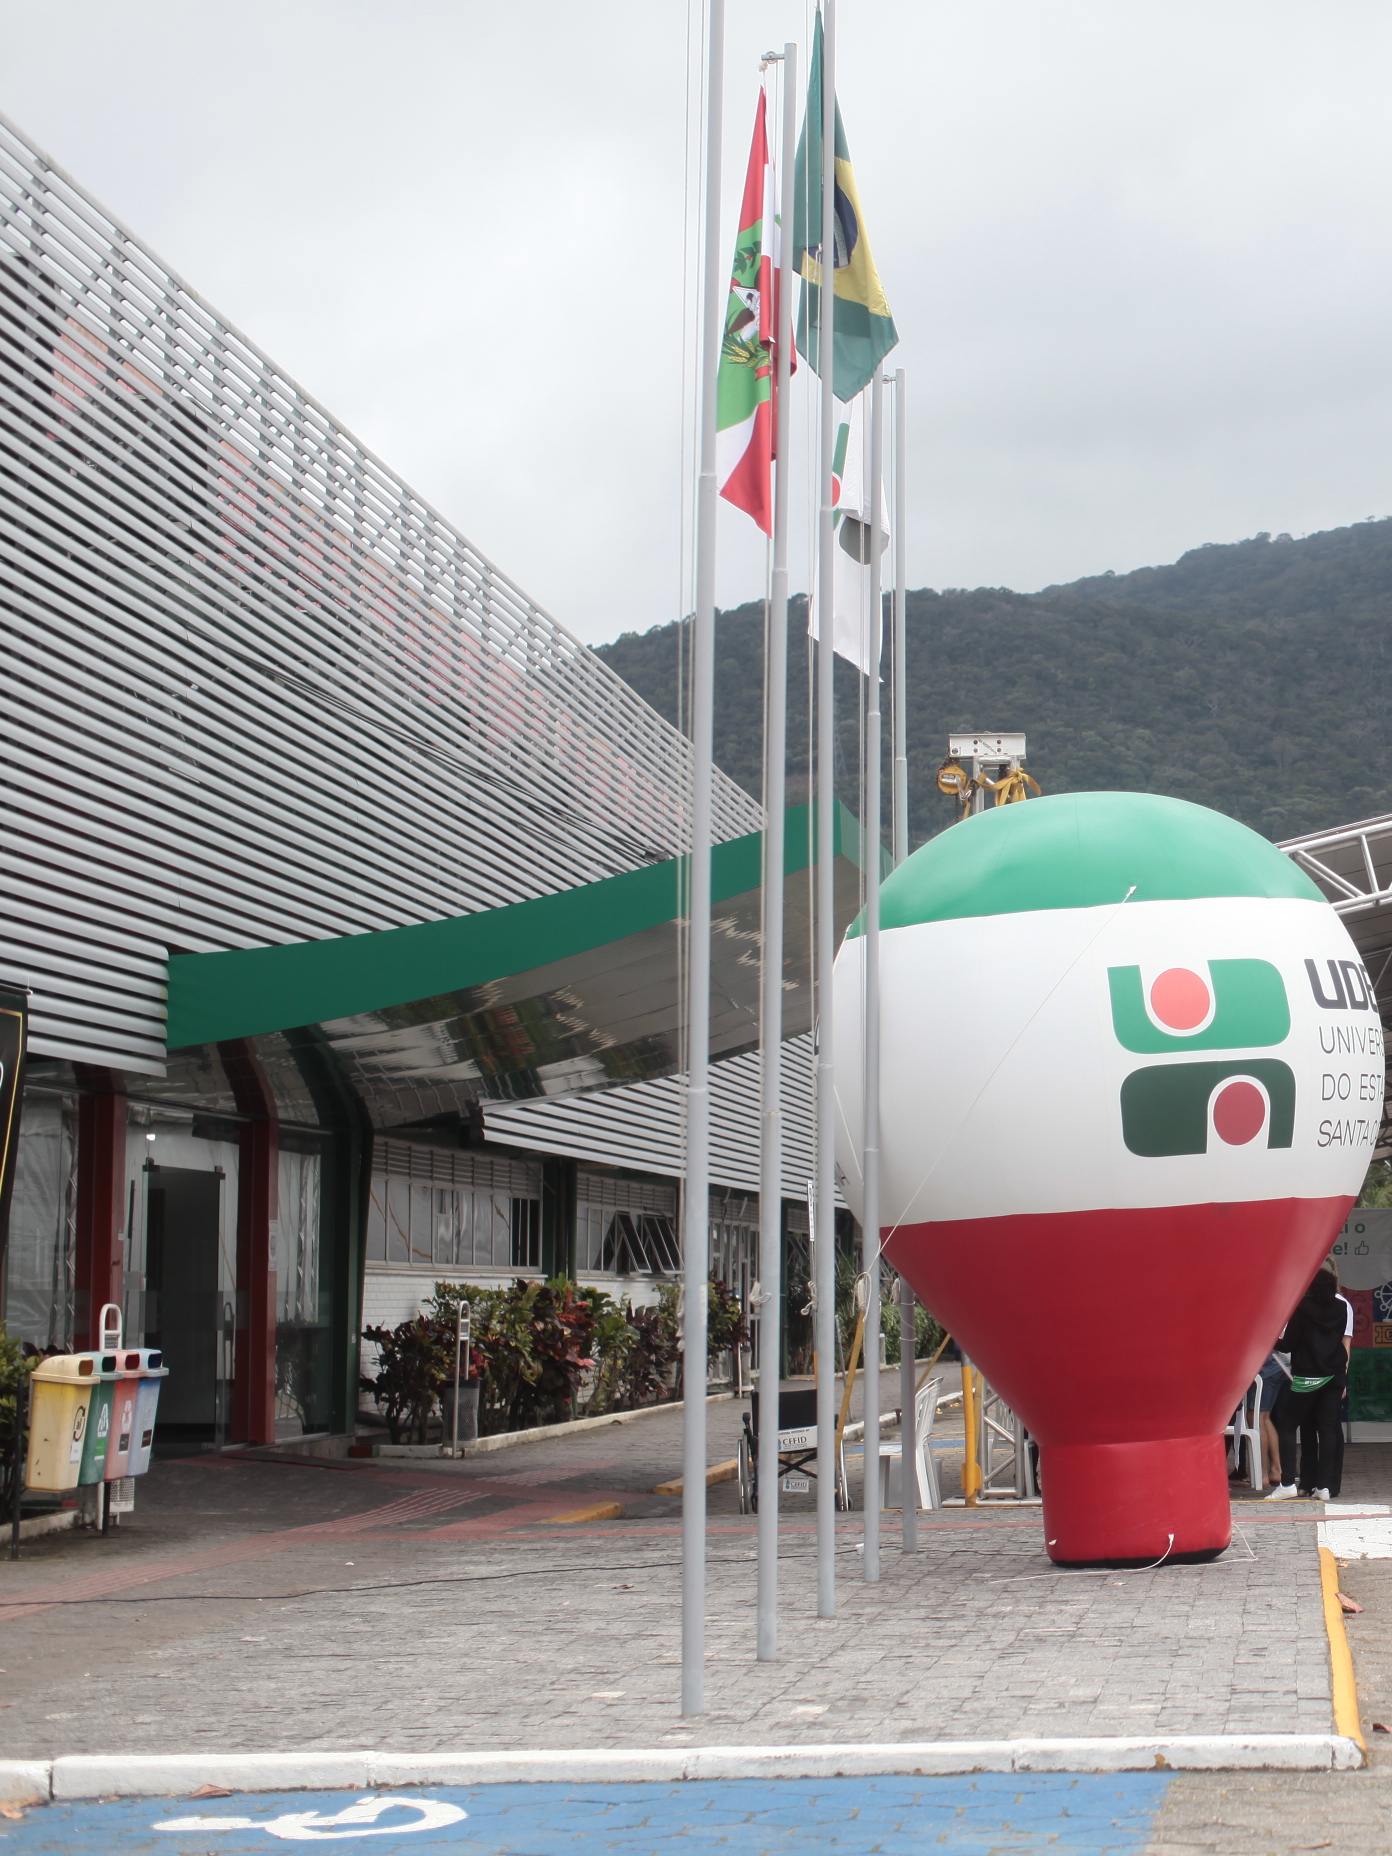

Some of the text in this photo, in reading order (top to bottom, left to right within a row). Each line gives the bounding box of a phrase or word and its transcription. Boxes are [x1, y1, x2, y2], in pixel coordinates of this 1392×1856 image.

[1322, 1072, 1351, 1101] DO
[1354, 1223, 1366, 1234] o
[1331, 1242, 1347, 1255] e!
[783, 1436, 806, 1445] CEFID
